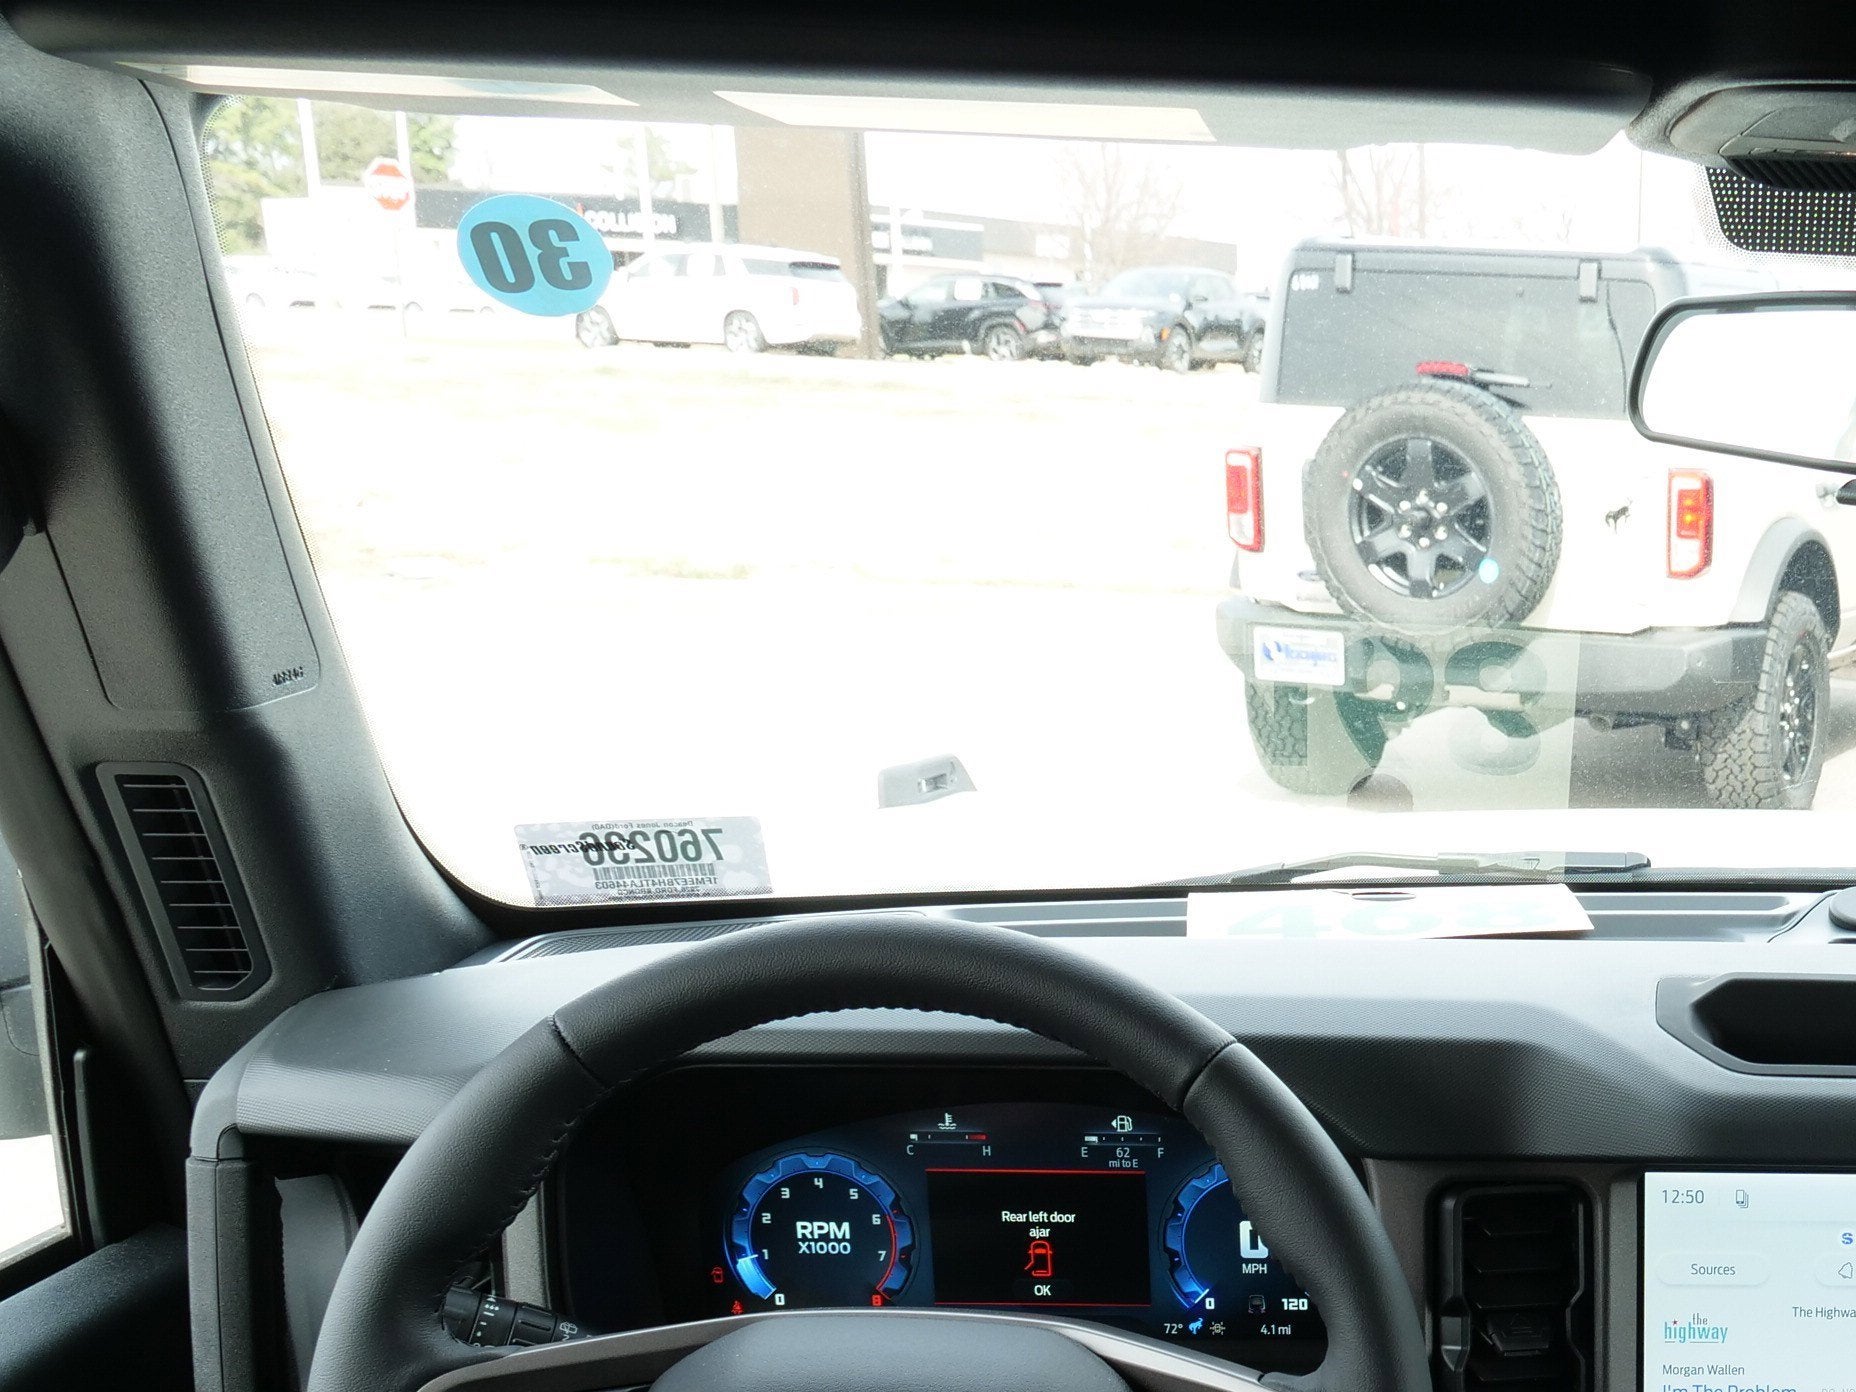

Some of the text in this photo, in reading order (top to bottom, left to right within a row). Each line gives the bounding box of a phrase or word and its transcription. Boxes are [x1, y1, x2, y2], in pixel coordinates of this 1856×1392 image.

[906, 1144, 914, 1155] C
[982, 1145, 991, 1156] H
[1081, 1146, 1089, 1158] E
[1115, 1147, 1130, 1158] 62
[1157, 1147, 1164, 1158] F
[1108, 1159, 1139, 1168] mi to E
[814, 1177, 824, 1189] 4
[780, 1187, 790, 1199] 3
[849, 1188, 859, 1200] 5
[1661, 1189, 1705, 1204] 12:50
[761, 1212, 772, 1224] 2
[871, 1214, 881, 1225] 6
[1001, 1210, 1076, 1223] Rear left door
[795, 1221, 850, 1240] RPM
[1029, 1227, 1051, 1239] ajar
[798, 1241, 851, 1255] X1000
[762, 1249, 769, 1260] 1
[878, 1250, 886, 1262] 7
[1242, 1263, 1268, 1274] MPH
[1690, 1263, 1736, 1276] Sources
[1034, 1285, 1052, 1296] OK
[775, 1293, 785, 1306] 0
[872, 1295, 882, 1307] 8
[1205, 1297, 1215, 1310] 0
[1281, 1298, 1309, 1311] 120
[1692, 1312, 1708, 1325] the
[1792, 1306, 1813, 1319] The
[1260, 1324, 1291, 1335] 4.1 mi
[1664, 1322, 1729, 1344] highway
[1662, 1364, 1745, 1378] Morgan Wallen
